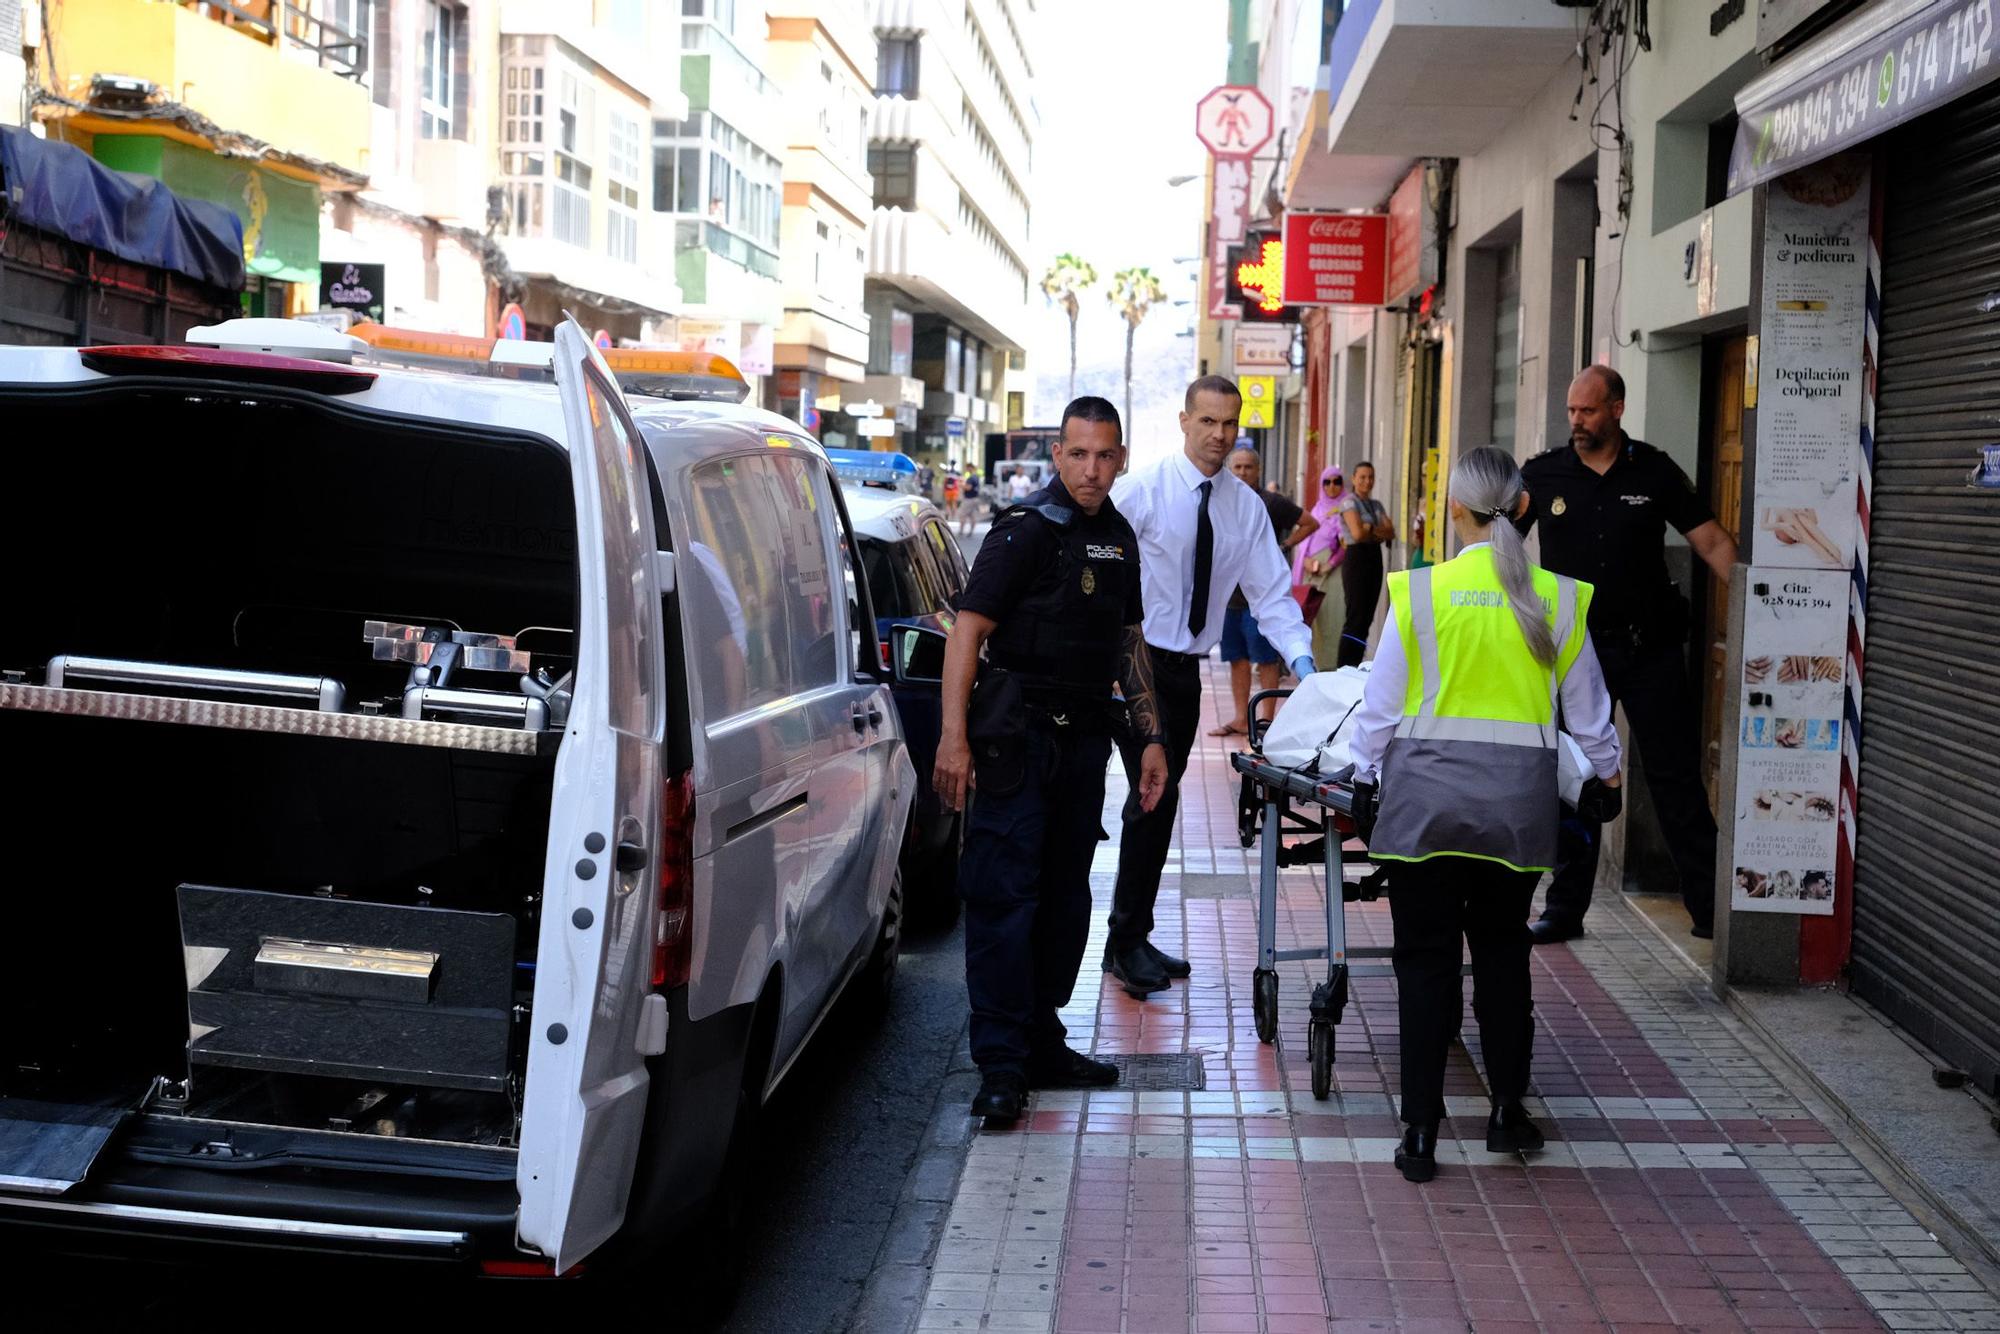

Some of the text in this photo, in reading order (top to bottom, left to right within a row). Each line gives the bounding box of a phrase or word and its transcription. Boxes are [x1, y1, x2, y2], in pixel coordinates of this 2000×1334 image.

[1767, 0, 1994, 164] 928 945 394 674 742
[1784, 232, 1850, 247] Manicura
[1308, 243, 1364, 257] REFRESCOS
[1777, 249, 1855, 265] & pedicura
[1308, 258, 1364, 272] GOLOSINAS
[1315, 273, 1356, 287] LICORES
[1315, 288, 1355, 301] TABACO
[1776, 367, 1850, 383] Depilación
[1782, 384, 1841, 399] corporal
[1783, 583, 1812, 594] Cita:
[1450, 590, 1505, 608] RECOGIDA
[1762, 596, 1832, 609] 928 945 394
